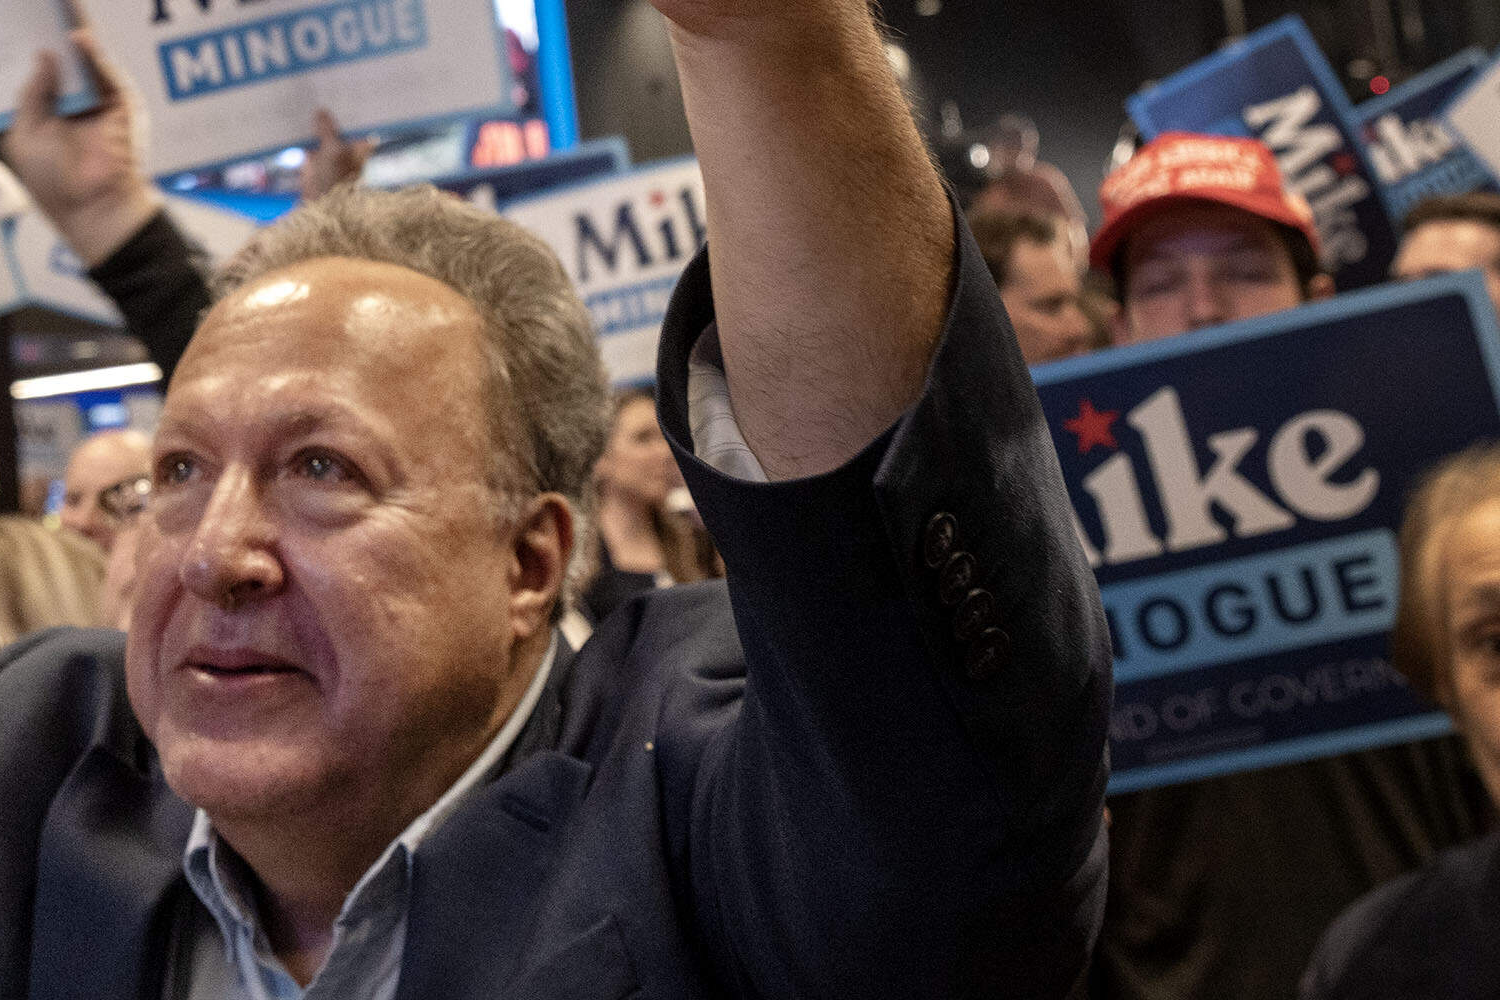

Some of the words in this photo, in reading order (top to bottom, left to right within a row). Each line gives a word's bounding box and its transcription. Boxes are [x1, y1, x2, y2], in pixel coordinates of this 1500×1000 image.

[572, 184, 707, 285] Mi
[1070, 385, 1381, 568] ike
[1103, 549, 1381, 662] OGUE
